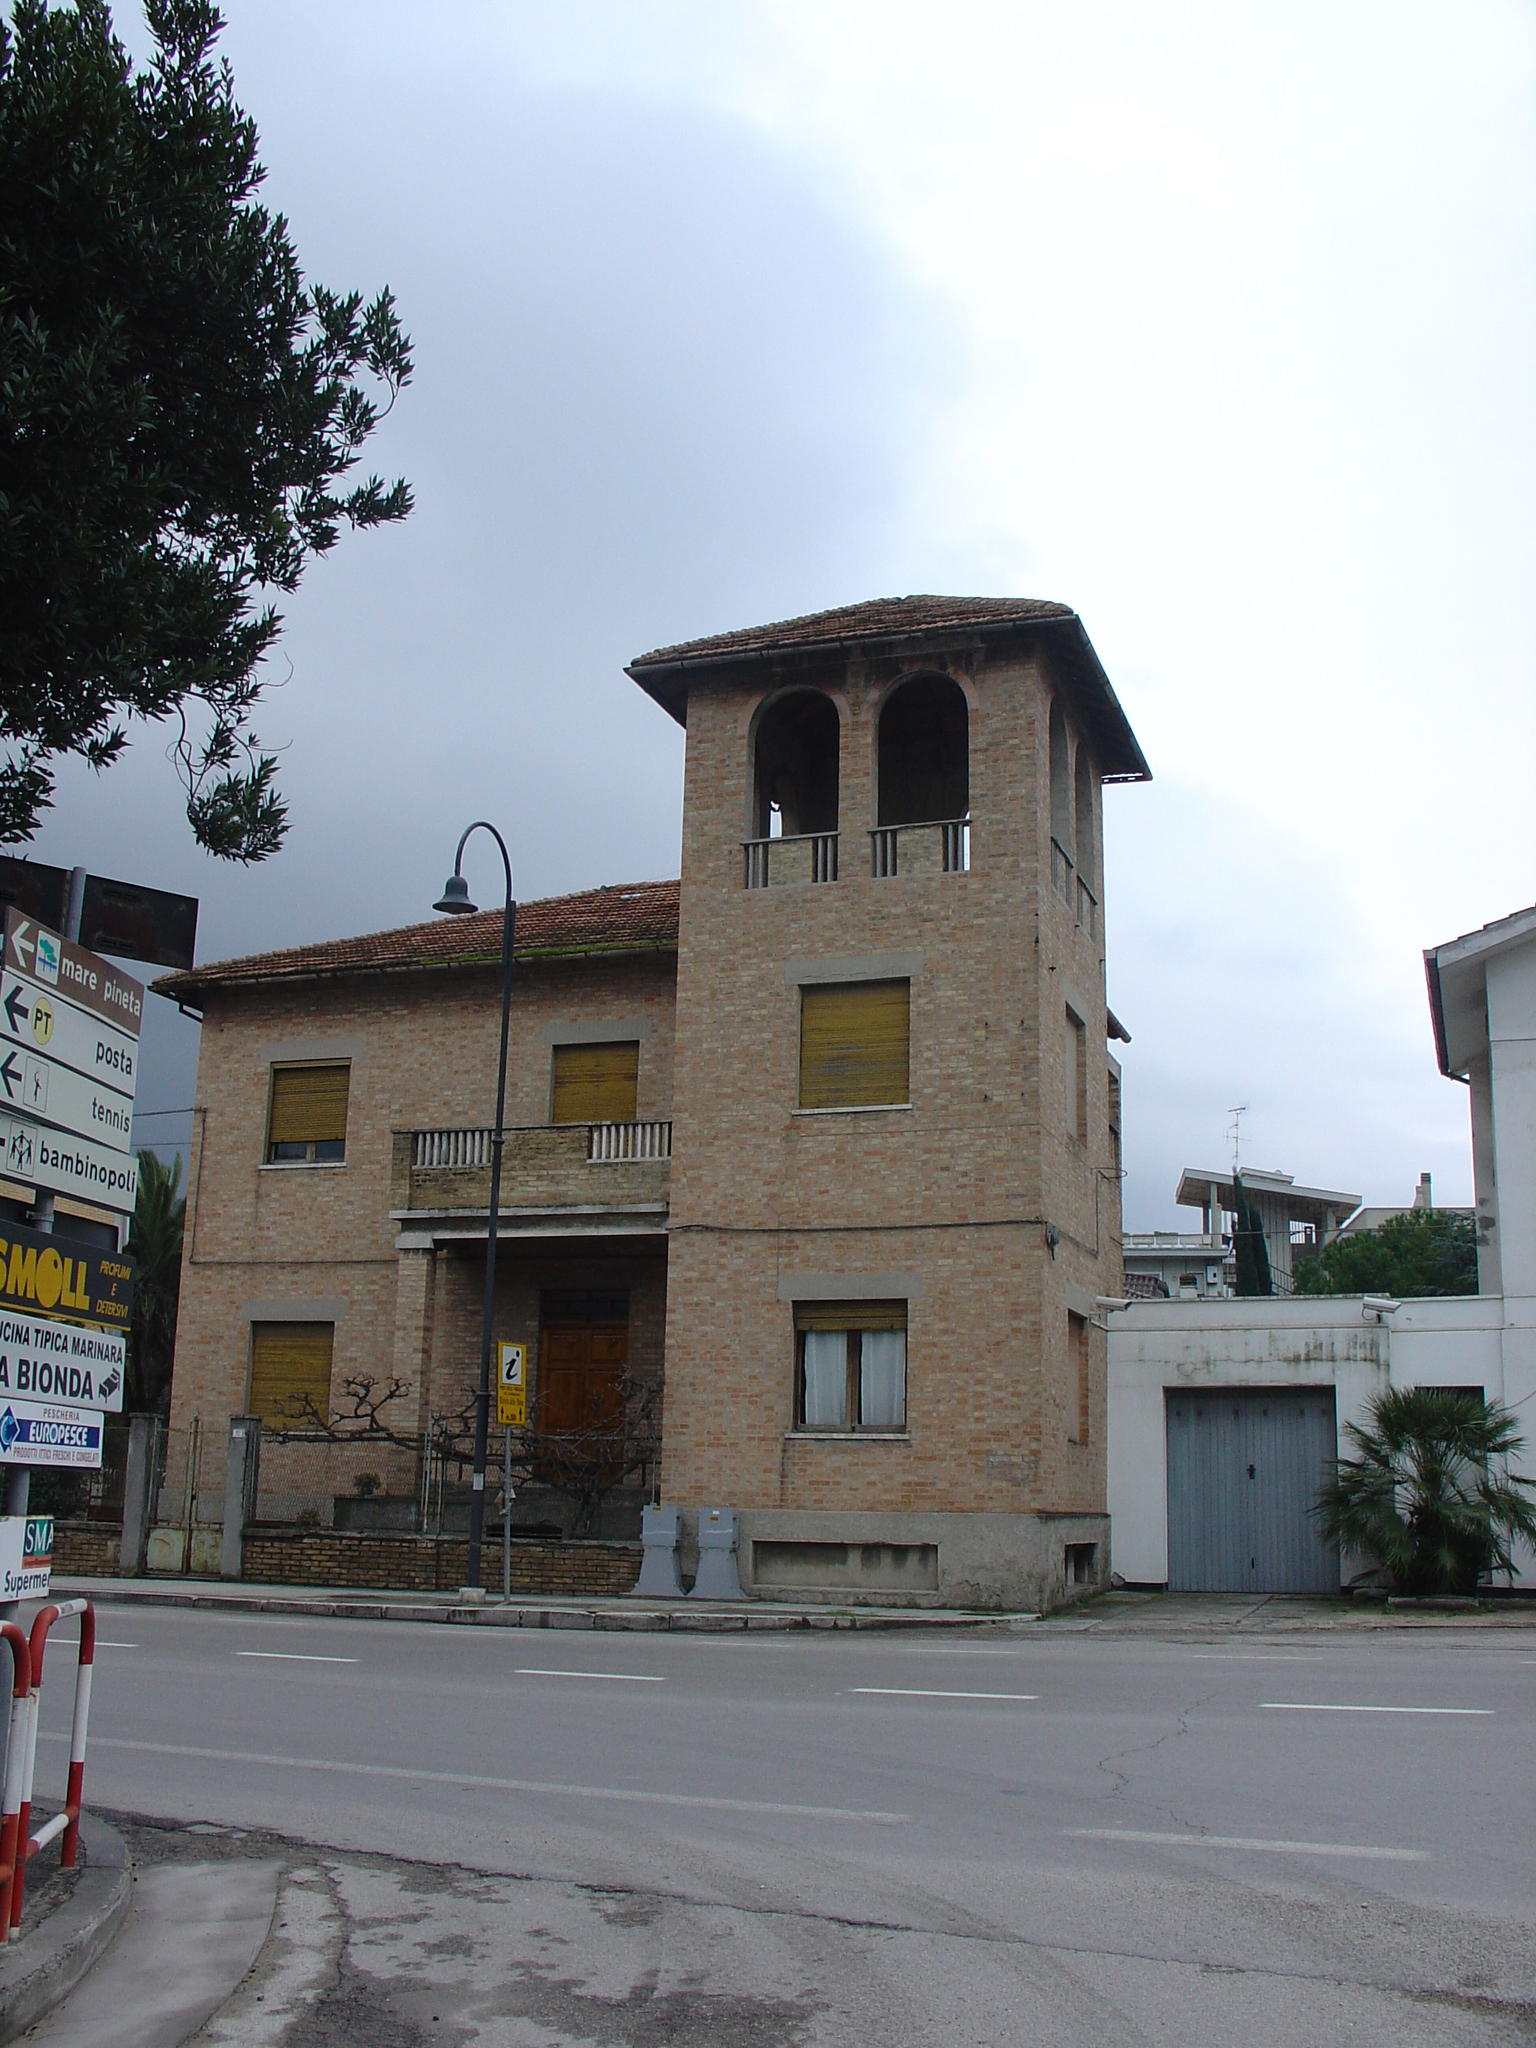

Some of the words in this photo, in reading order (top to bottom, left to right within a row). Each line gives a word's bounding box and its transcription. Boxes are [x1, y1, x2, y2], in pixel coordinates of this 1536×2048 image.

[61, 957, 98, 991] mare
[103, 979, 141, 1018] pineta
[33, 1007, 52, 1036] PT
[95, 1041, 133, 1076] posta
[92, 1096, 131, 1133] tennis
[39, 1140, 137, 1193] bambinopoli
[99, 1260, 132, 1280] PROFUMI
[111, 1283, 118, 1297] E
[95, 1300, 129, 1319] DETERSIVI
[34, 1328, 69, 1354] TIPICA
[71, 1336, 123, 1365] MARINARA
[16, 1358, 94, 1401] BIONDA
[43, 1407, 81, 1421] PESCHERIA
[28, 1421, 89, 1447] EUROPESCE
